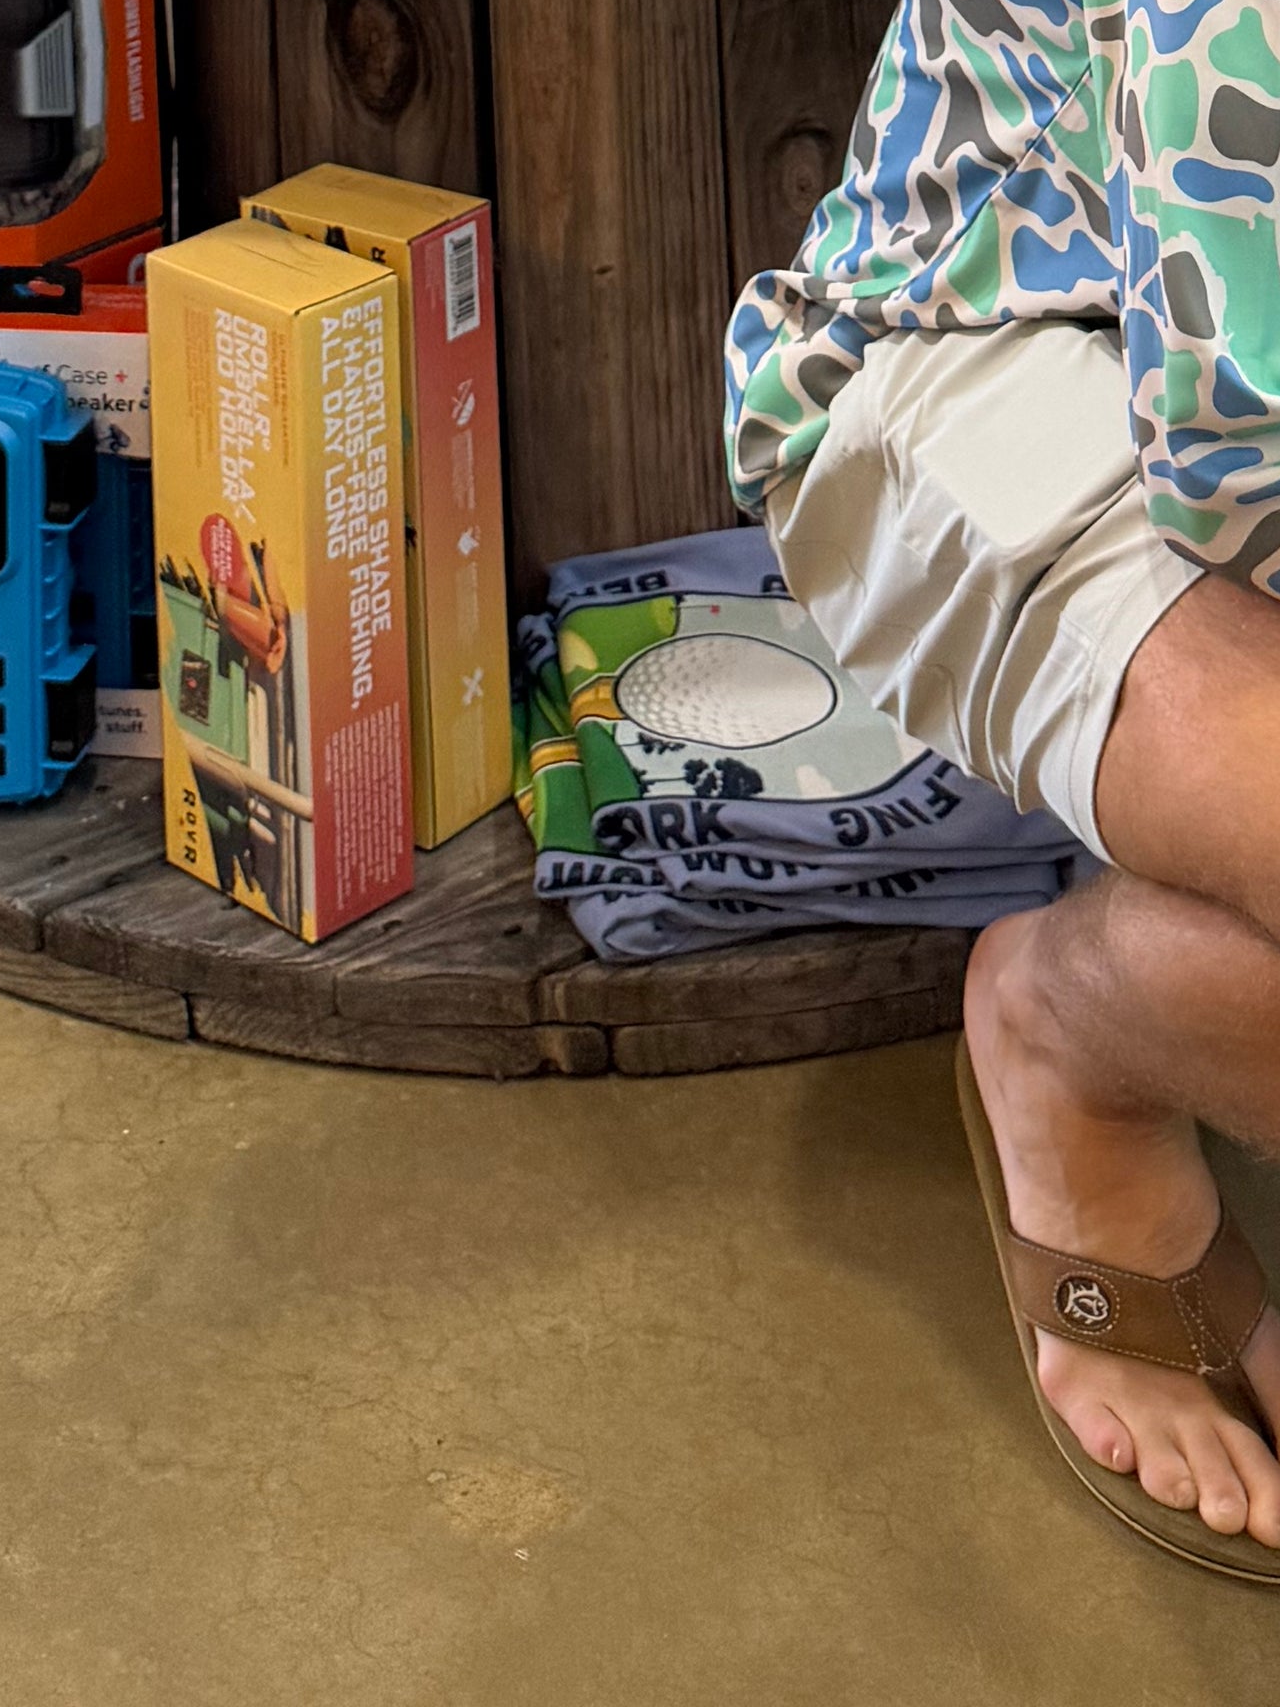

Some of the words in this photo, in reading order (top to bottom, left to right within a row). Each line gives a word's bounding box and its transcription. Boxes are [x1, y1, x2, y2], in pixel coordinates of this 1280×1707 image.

[126, 40, 145, 122] FLASHLIGHT
[56, 364, 108, 386] Case
[214, 307, 236, 378] ROD
[322, 317, 341, 385] ALL
[218, 386, 240, 503] HOLDR
[323, 390, 345, 453] DAY
[343, 338, 369, 560] HANDS-FREE
[362, 295, 388, 512] EFFORTLESS
[324, 463, 348, 560] LONG
[368, 518, 393, 632] SHADE
[349, 567, 374, 711] FISHING,
